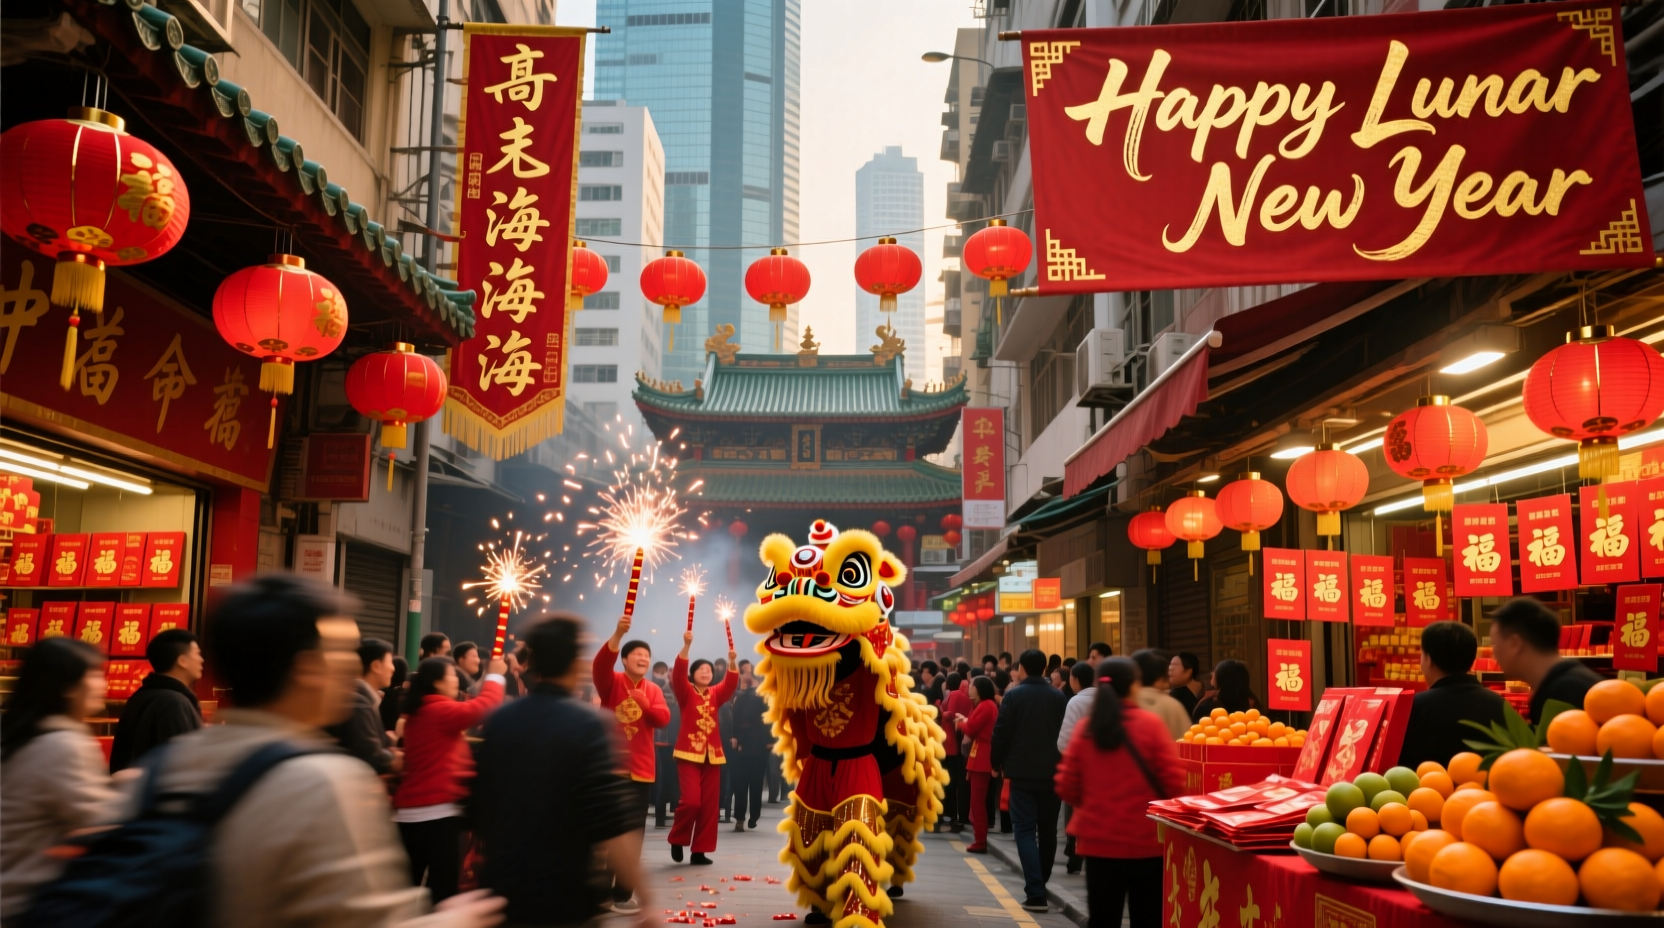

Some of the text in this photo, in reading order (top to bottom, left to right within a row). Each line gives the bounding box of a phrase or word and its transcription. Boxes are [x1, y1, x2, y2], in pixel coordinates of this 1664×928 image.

[1064, 39, 1601, 181] Happy Lunar
[1162, 144, 1594, 262] New Year
[1527, 526, 1566, 567] 福
[1589, 514, 1629, 557] 福
[14, 552, 35, 575] 福
[55, 551, 77, 574] 福
[94, 550, 117, 574] 福
[150, 549, 173, 574] 福
[1461, 533, 1501, 572] 福
[1271, 572, 1298, 602] 福
[1313, 573, 1341, 603] 福
[1359, 578, 1387, 608] 福
[1412, 581, 1440, 610] 福
[118, 620, 141, 645] 福
[1621, 612, 1650, 647] 福
[1275, 663, 1303, 692] 福
